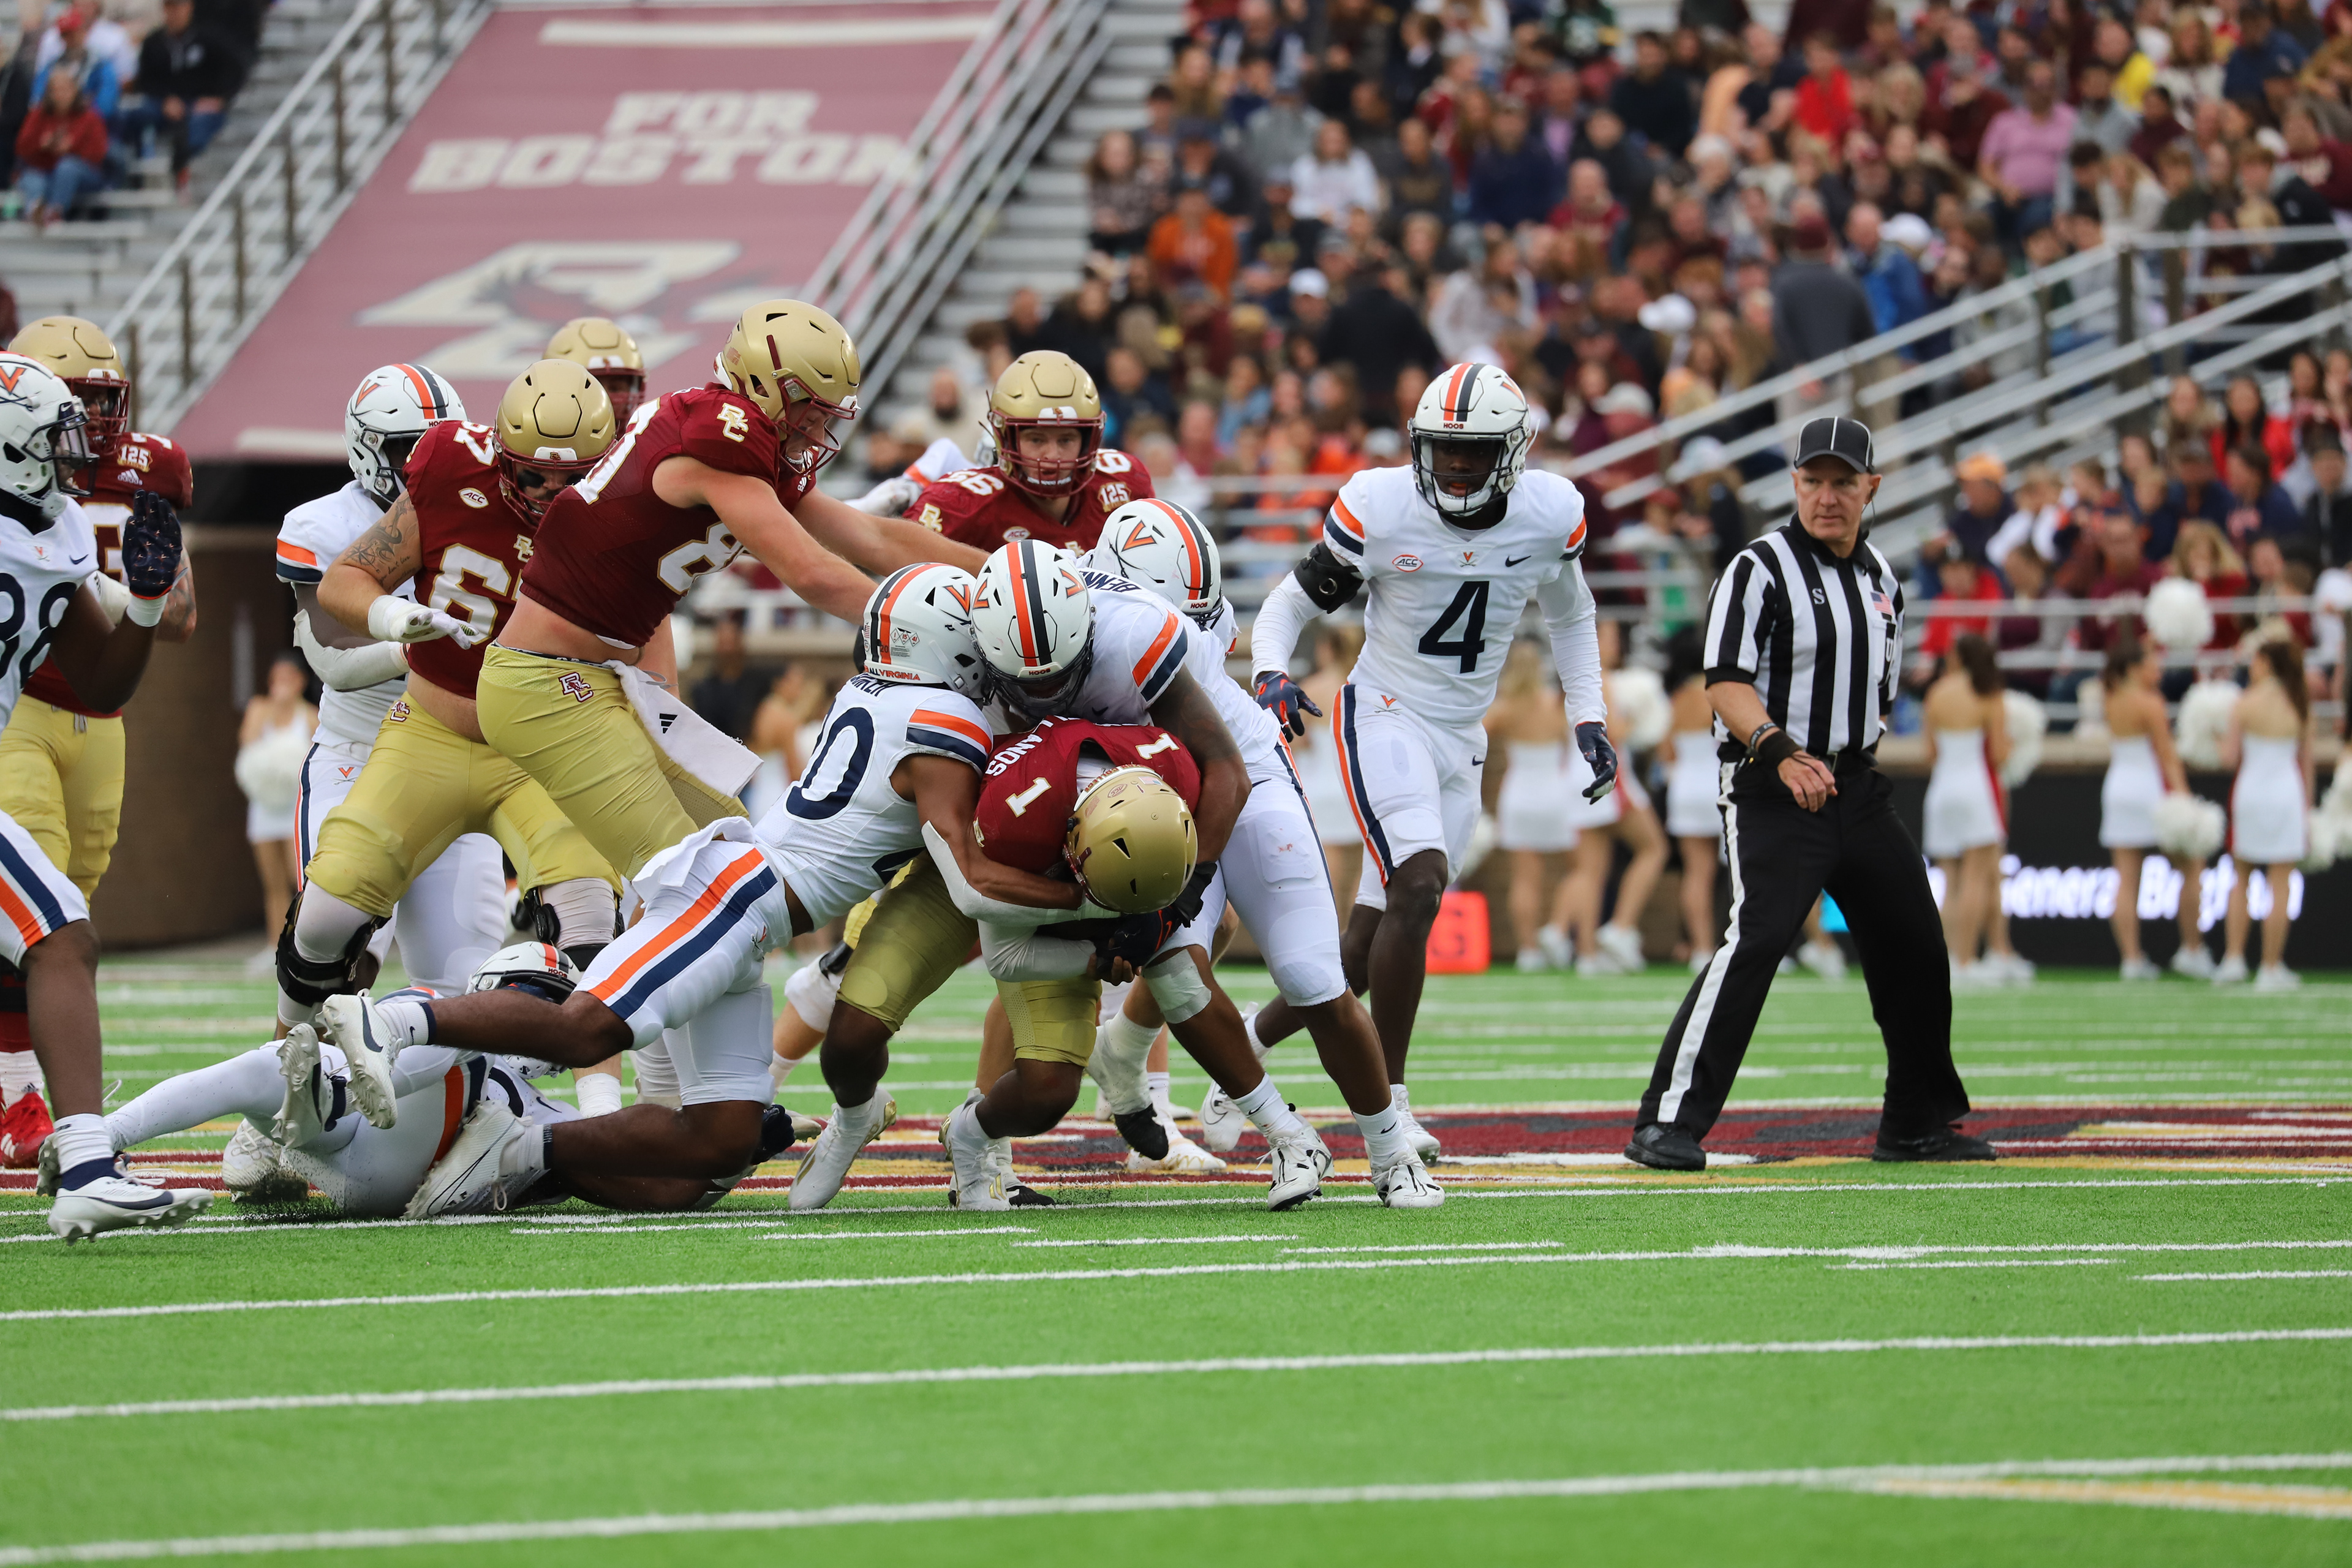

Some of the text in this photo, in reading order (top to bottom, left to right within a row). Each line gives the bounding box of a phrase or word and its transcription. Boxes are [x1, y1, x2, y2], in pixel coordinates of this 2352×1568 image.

[605, 91, 820, 135] FOR
[407, 132, 914, 194] BOSTON
[121, 445, 148, 467] 125
[462, 492, 486, 504] ACC
[1101, 483, 1129, 507] 125
[1006, 529, 1027, 538] ACC
[429, 543, 525, 646] 6
[1812, 588, 1825, 605] S
[1418, 581, 1490, 674] 4
[1028, 667, 1051, 676] HOOS
[786, 697, 876, 821] 0
[1136, 733, 1180, 760] 1
[1005, 777, 1052, 818] 1
[1999, 854, 2121, 918] enera
